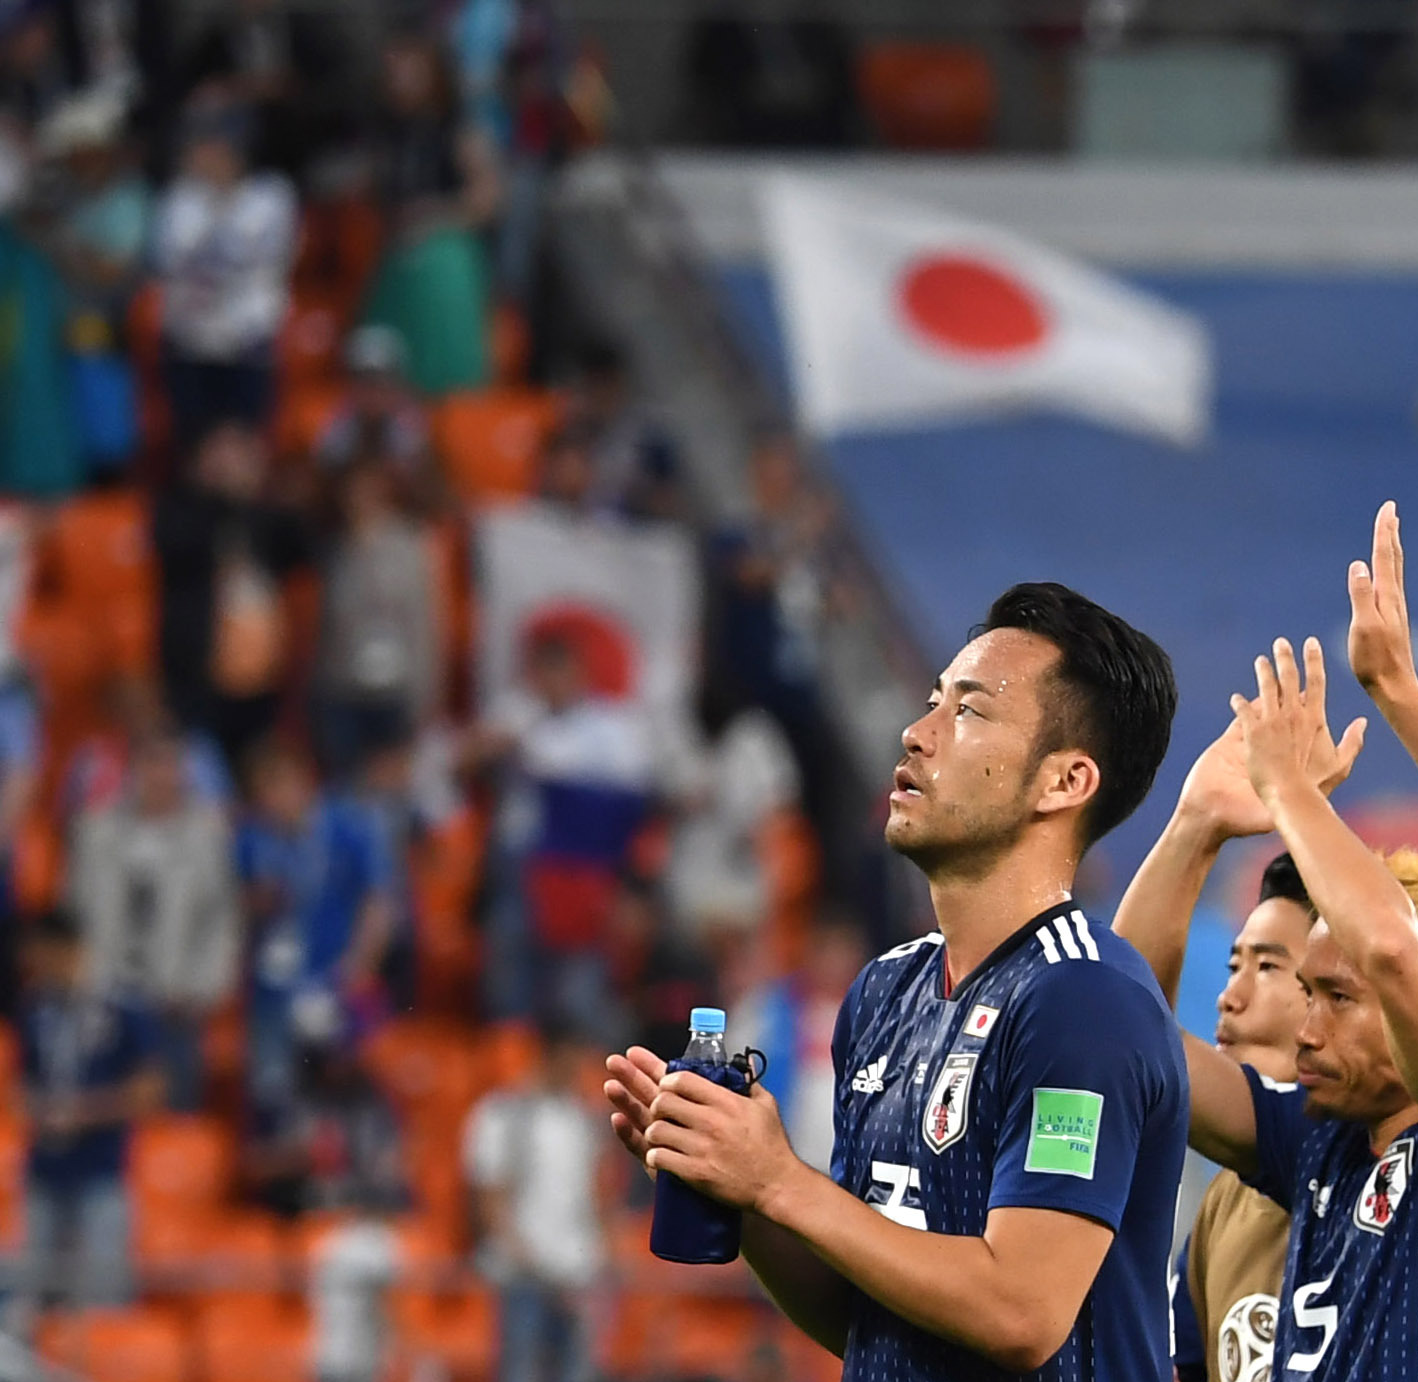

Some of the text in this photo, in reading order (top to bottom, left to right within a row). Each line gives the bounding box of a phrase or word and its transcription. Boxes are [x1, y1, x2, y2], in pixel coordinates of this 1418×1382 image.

[1038, 1113, 1094, 1127] LIVING
[1037, 1123, 1092, 1136] FOOTBALL
[1069, 1142, 1090, 1153] FIFA
[1287, 1268, 1339, 1372] 5
